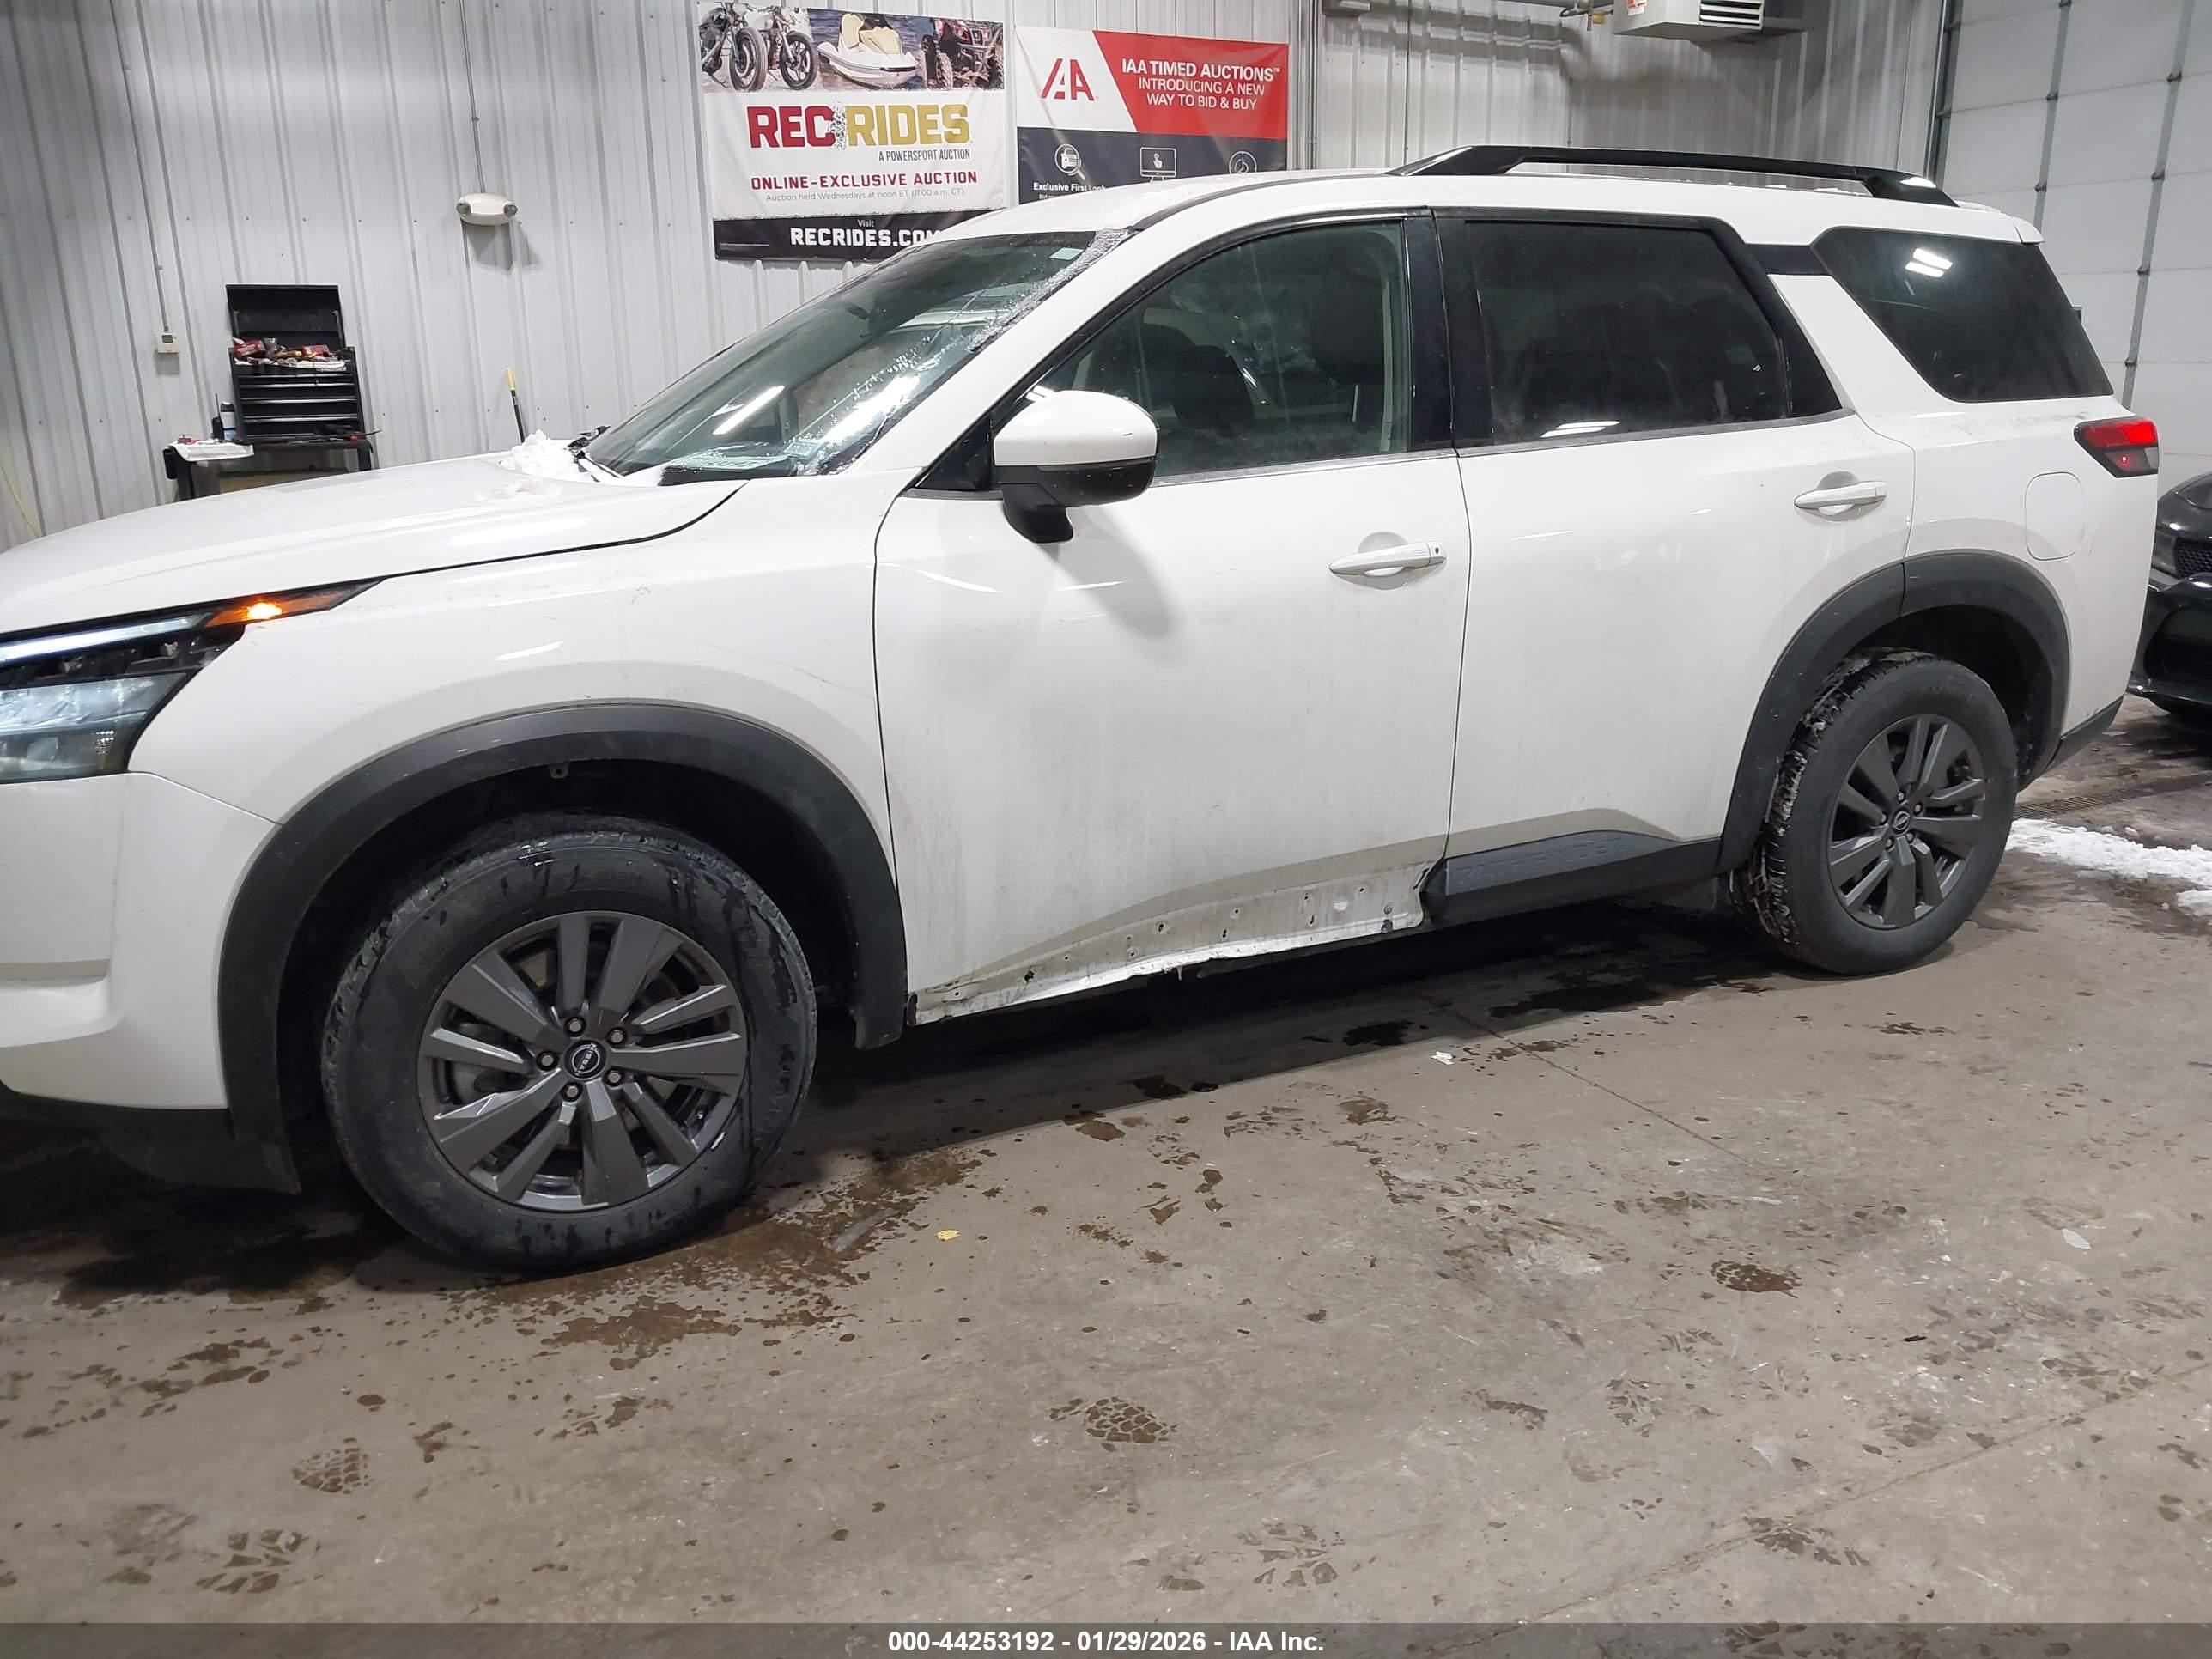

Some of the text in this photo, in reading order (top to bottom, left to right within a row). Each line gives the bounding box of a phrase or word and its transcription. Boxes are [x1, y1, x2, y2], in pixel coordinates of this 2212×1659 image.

[1121, 58, 1148, 74] IAA
[1149, 60, 1197, 77] TIMED
[1139, 76, 1265, 96] INTRODUCING A NEW
[1147, 93, 1257, 110] WAY TO BID & BUY
[747, 103, 971, 149] REC RIDES
[878, 149, 970, 162] A POWERSPORT AUCTION
[750, 171, 978, 191] ONLINE-EXCLUSIVE AUCTION
[1033, 182, 1070, 191] Exclusive
[1071, 183, 1087, 191] First
[817, 191, 866, 200] Wednesdays
[858, 219, 875, 228] Visit
